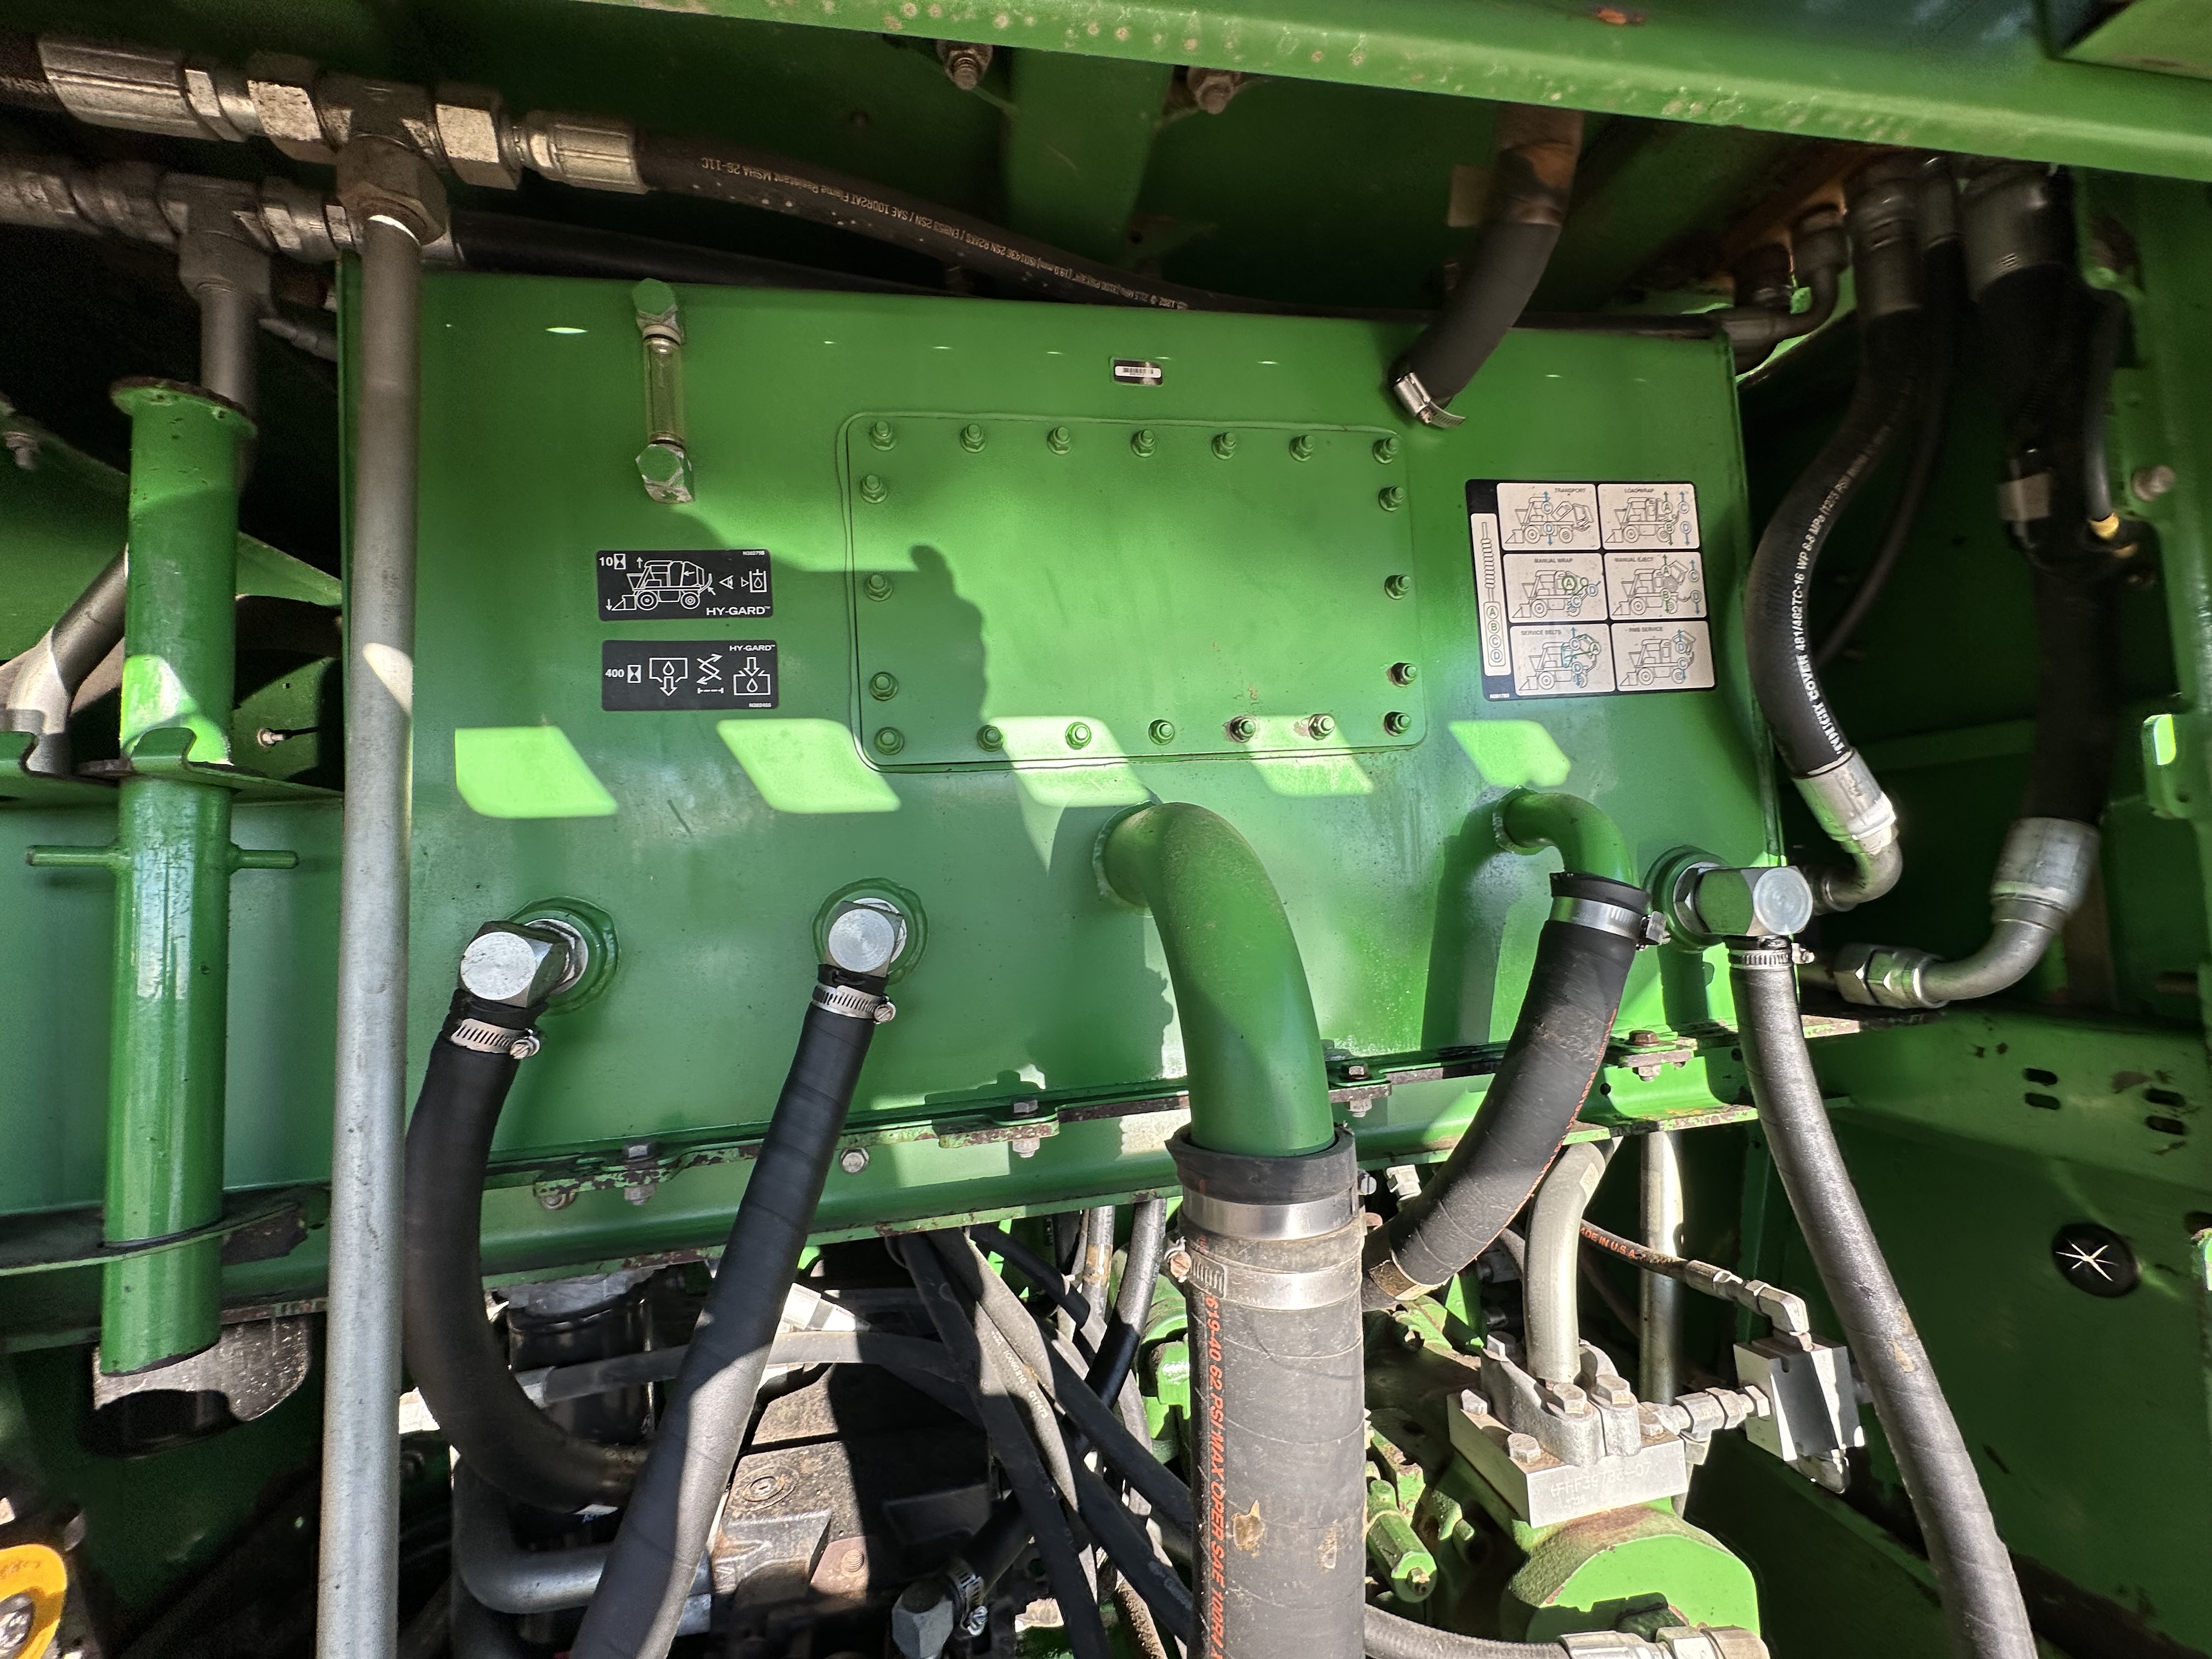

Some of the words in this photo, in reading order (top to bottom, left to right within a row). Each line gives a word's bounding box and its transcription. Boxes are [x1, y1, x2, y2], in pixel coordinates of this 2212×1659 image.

[891, 206, 908, 221] SAE
[599, 557, 613, 566] 10
[1796, 551, 1809, 571] WP
[605, 669, 624, 678] 400
[1580, 1227, 1598, 1242] ADE
[1599, 1235, 1610, 1247] IN
[1205, 1295, 1223, 1362] 619-40
[1209, 1363, 1223, 1391] 62
[1209, 1392, 1224, 1431] PSI
[1210, 1430, 1225, 1481] MAX
[1210, 1480, 1226, 1542] OPER
[1210, 1540, 1226, 1588] SAE
